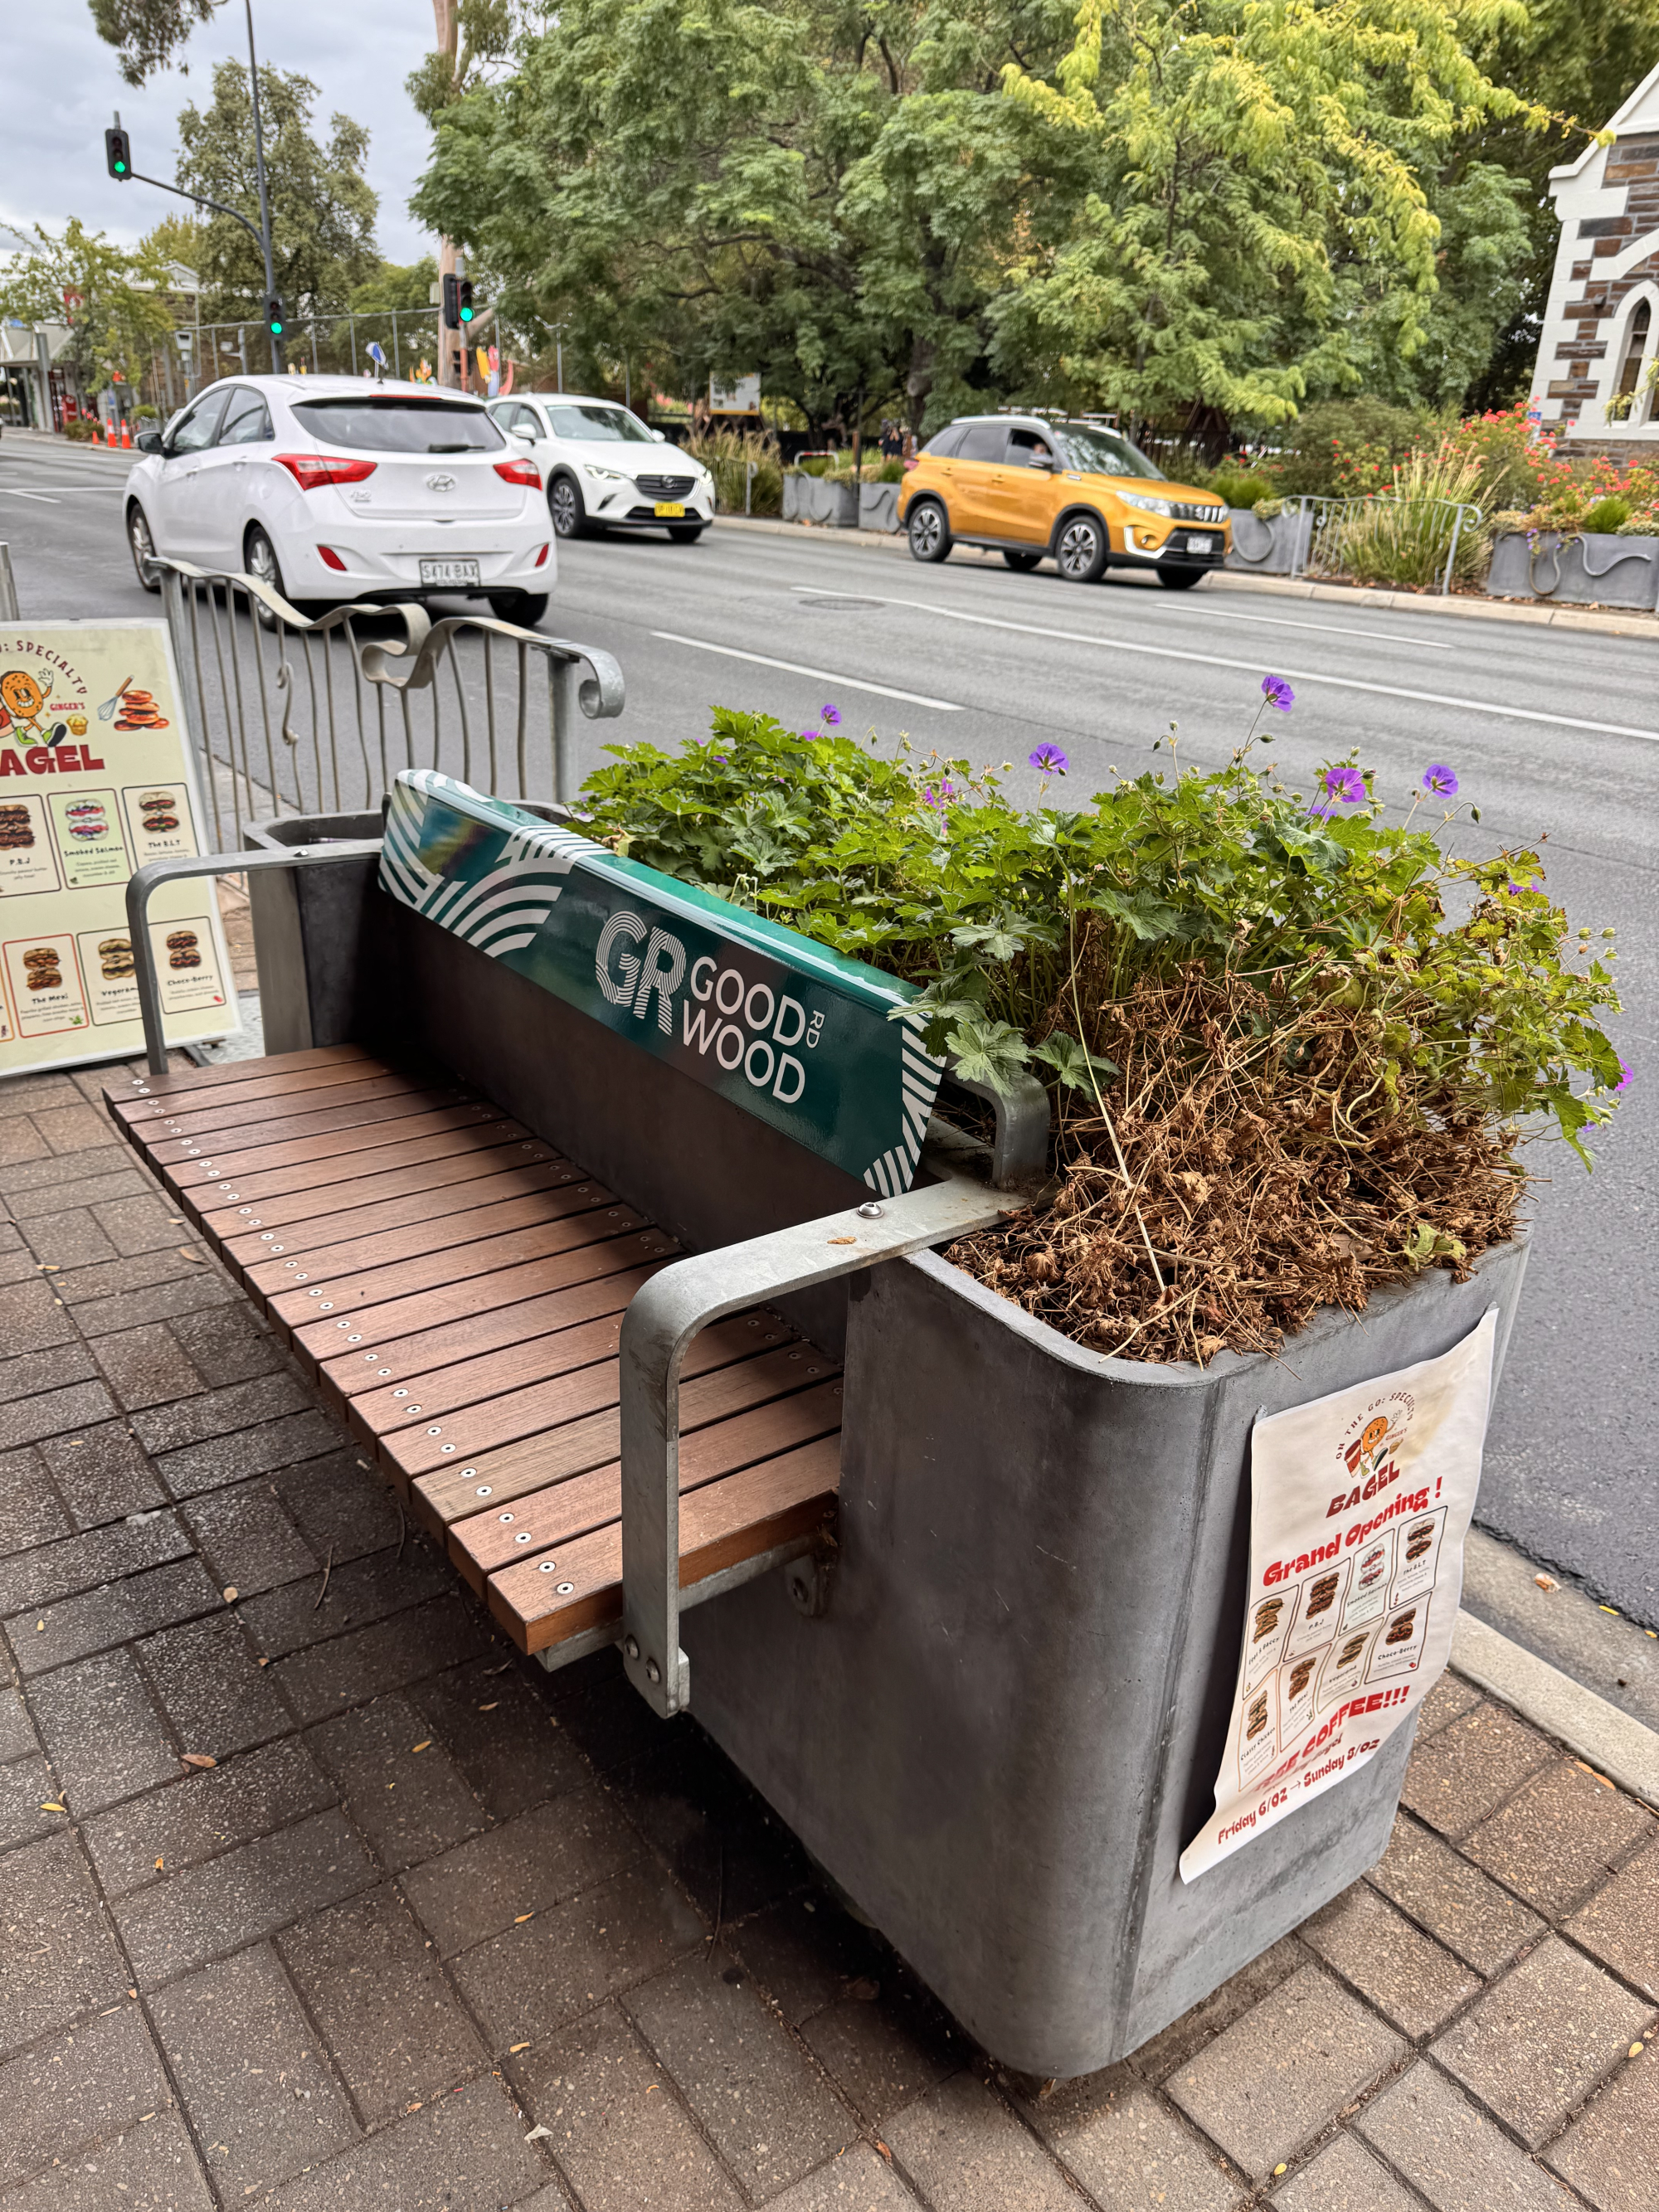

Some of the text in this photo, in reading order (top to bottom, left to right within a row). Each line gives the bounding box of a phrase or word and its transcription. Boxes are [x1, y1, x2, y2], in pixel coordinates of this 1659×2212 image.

[17, 639, 87, 694] SPECIALTY
[50, 702, 85, 712] GINGER'S
[101, 986, 139, 996] Vegoram
[168, 975, 213, 986] Choco-Berry
[595, 911, 687, 1037] GR
[690, 956, 806, 1047] GOOD
[683, 999, 805, 1104] WOOD
[805, 1009, 825, 1049] RD
[1335, 1443, 1345, 1460] ON
[1345, 1413, 1364, 1436] THE
[1368, 1398, 1385, 1412] GO:
[1326, 1460, 1400, 1519] BAGEL
[1262, 1533, 1342, 1587] Grand
[1378, 1645, 1418, 1660] Choco-Berry
[1301, 1685, 1410, 1757] COFFEE!!!
[1218, 1811, 1257, 1845] Friday
[1303, 1755, 1345, 1787] Sunday
